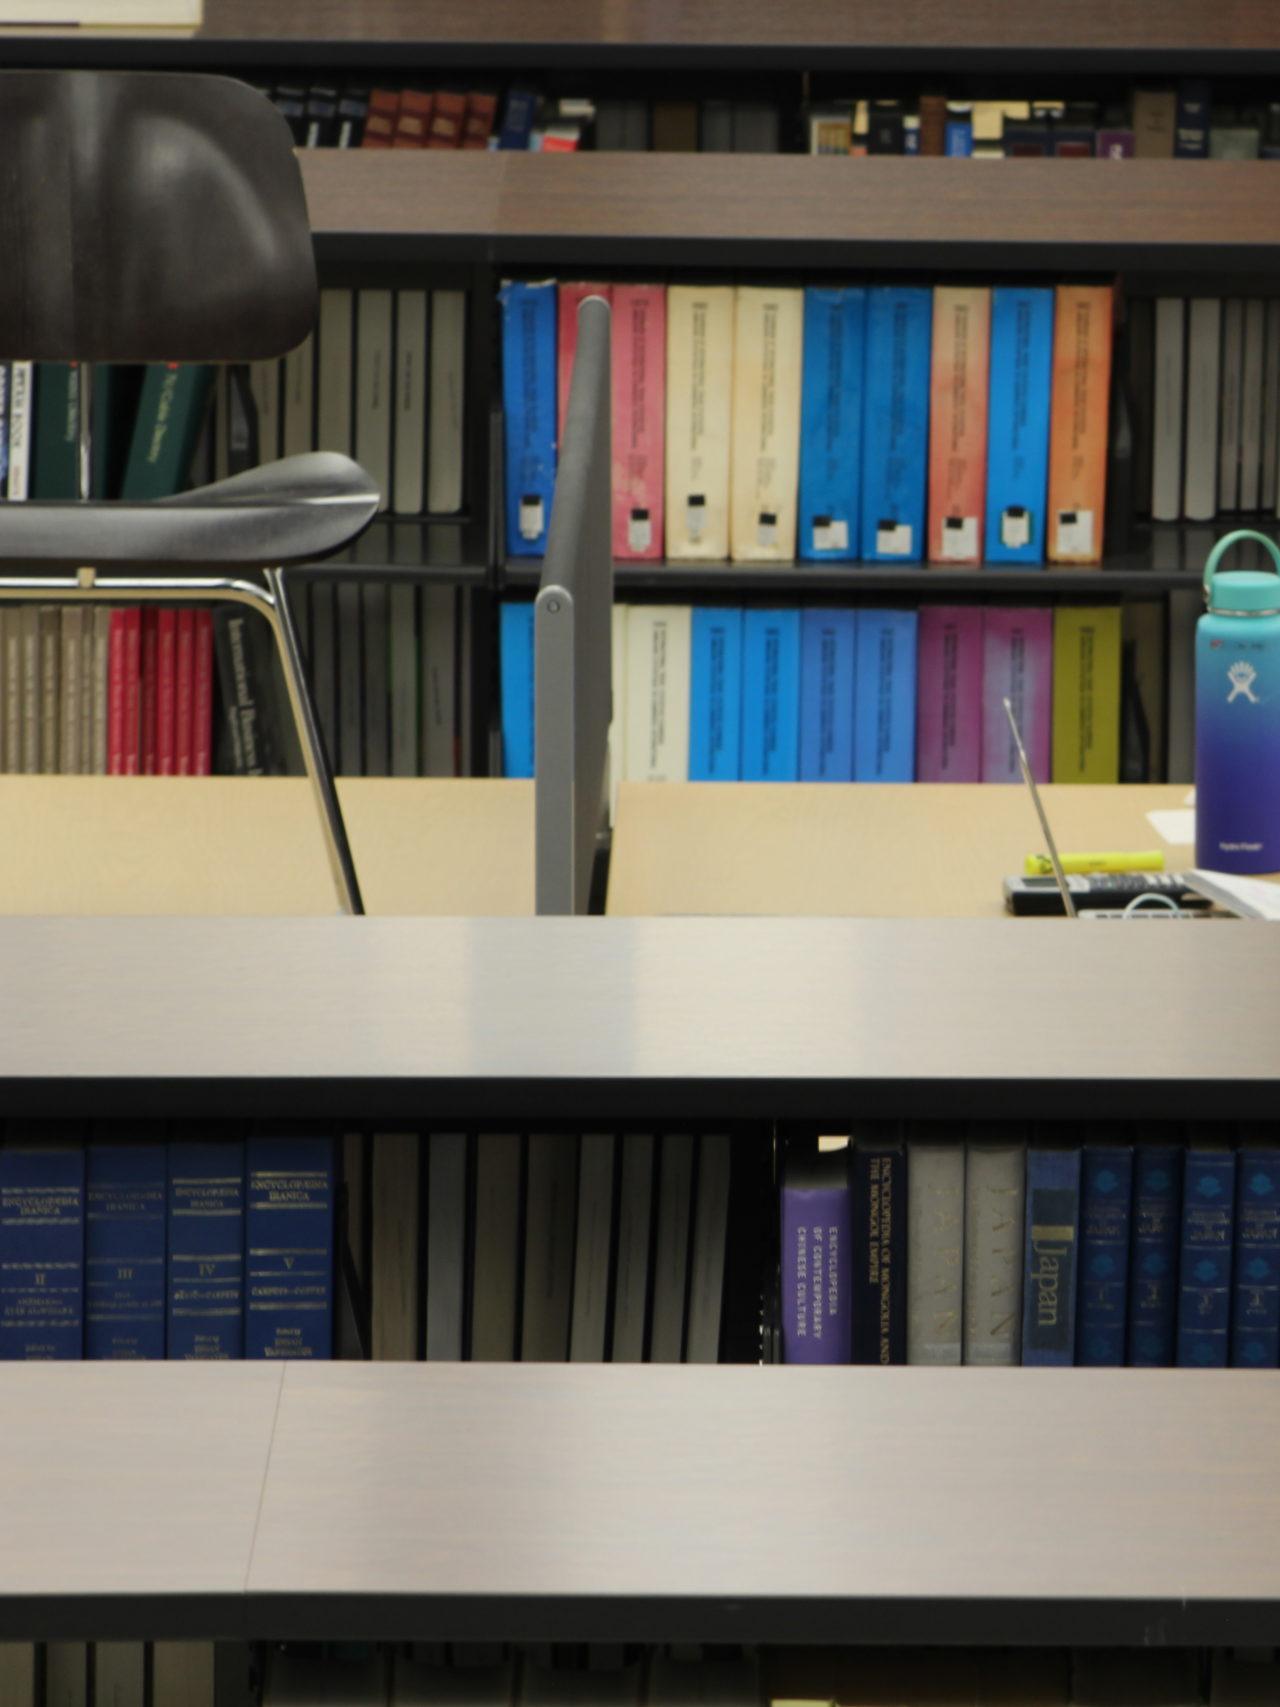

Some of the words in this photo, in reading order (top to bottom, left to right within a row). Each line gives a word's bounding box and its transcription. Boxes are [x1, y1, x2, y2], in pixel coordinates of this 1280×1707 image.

[870, 1158, 879, 1180] THE
[268, 1191, 310, 1202] IRANICA
[869, 1184, 879, 1238] MONGOL
[797, 1226, 807, 1279] CHINESE
[813, 1226, 822, 1243] OF
[117, 1268, 134, 1279] III
[199, 1264, 216, 1277] IV
[283, 1257, 295, 1269] V
[828, 1226, 839, 1316] ENCYCLOPEDIA
[868, 1242, 878, 1284] EMPIRE
[881, 1249, 891, 1265] OF
[986, 1185, 1019, 1339] JAPAN
[812, 1245, 822, 1339] CONTEMPORARY
[880, 1268, 890, 1333] MONGOLIA
[1030, 1239, 1067, 1327] Japan
[796, 1282, 806, 1338] CULTURE
[879, 1337, 889, 1364] AND
